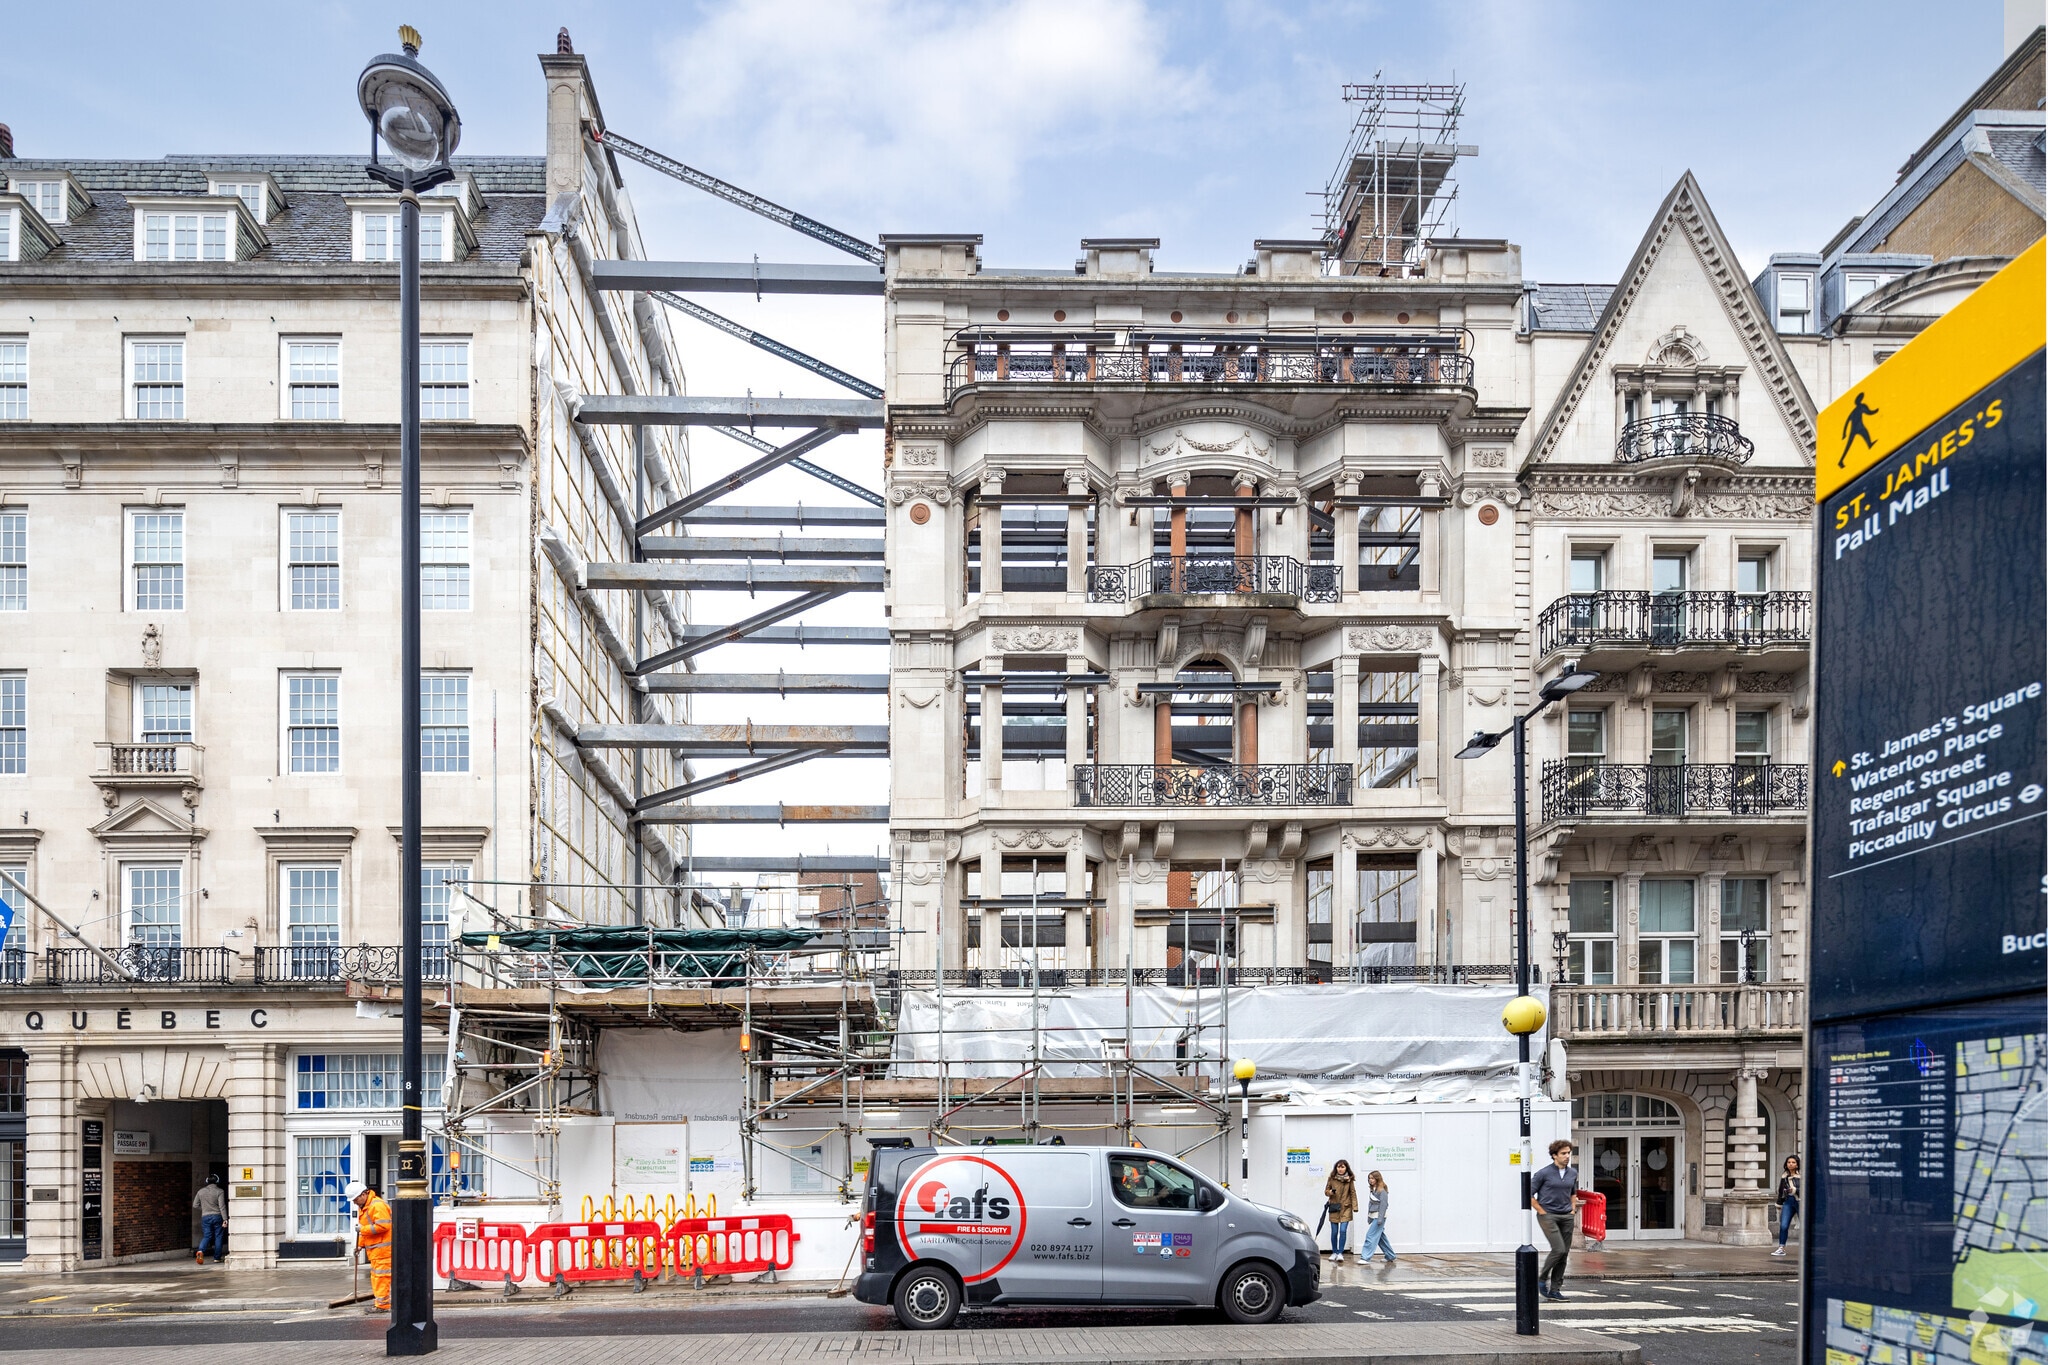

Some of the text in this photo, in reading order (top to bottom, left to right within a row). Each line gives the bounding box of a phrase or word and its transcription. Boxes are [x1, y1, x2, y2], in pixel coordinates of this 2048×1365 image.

[1835, 399, 2003, 530] ST. JAMES'S
[1835, 466, 1950, 560] Pall Mall
[1851, 681, 2042, 770] St. James's Square
[1850, 723, 2003, 792] Waterloo Place
[1850, 753, 1986, 815] Regent Street
[1849, 771, 2012, 836] Trafalgar Square
[1849, 796, 2012, 859] Piccadilly Circus
[2002, 928, 2047, 954] Buc
[25, 1007, 268, 1031] QUÉBEC
[1831, 1053, 1856, 1062] Walking
[1857, 1051, 1873, 1059] from
[1845, 1065, 1889, 1075] Charing Cross
[405, 1081, 412, 1090] 8
[363, 1119, 371, 1127] 59
[372, 1119, 391, 1127] PALL
[1829, 1142, 1846, 1150] Royal
[1847, 1142, 1877, 1150] Academy
[984, 1238, 1011, 1246] Services
[1030, 1244, 1094, 1252] 020 8974 1177
[1034, 1252, 1090, 1261] www.fafs.biz
